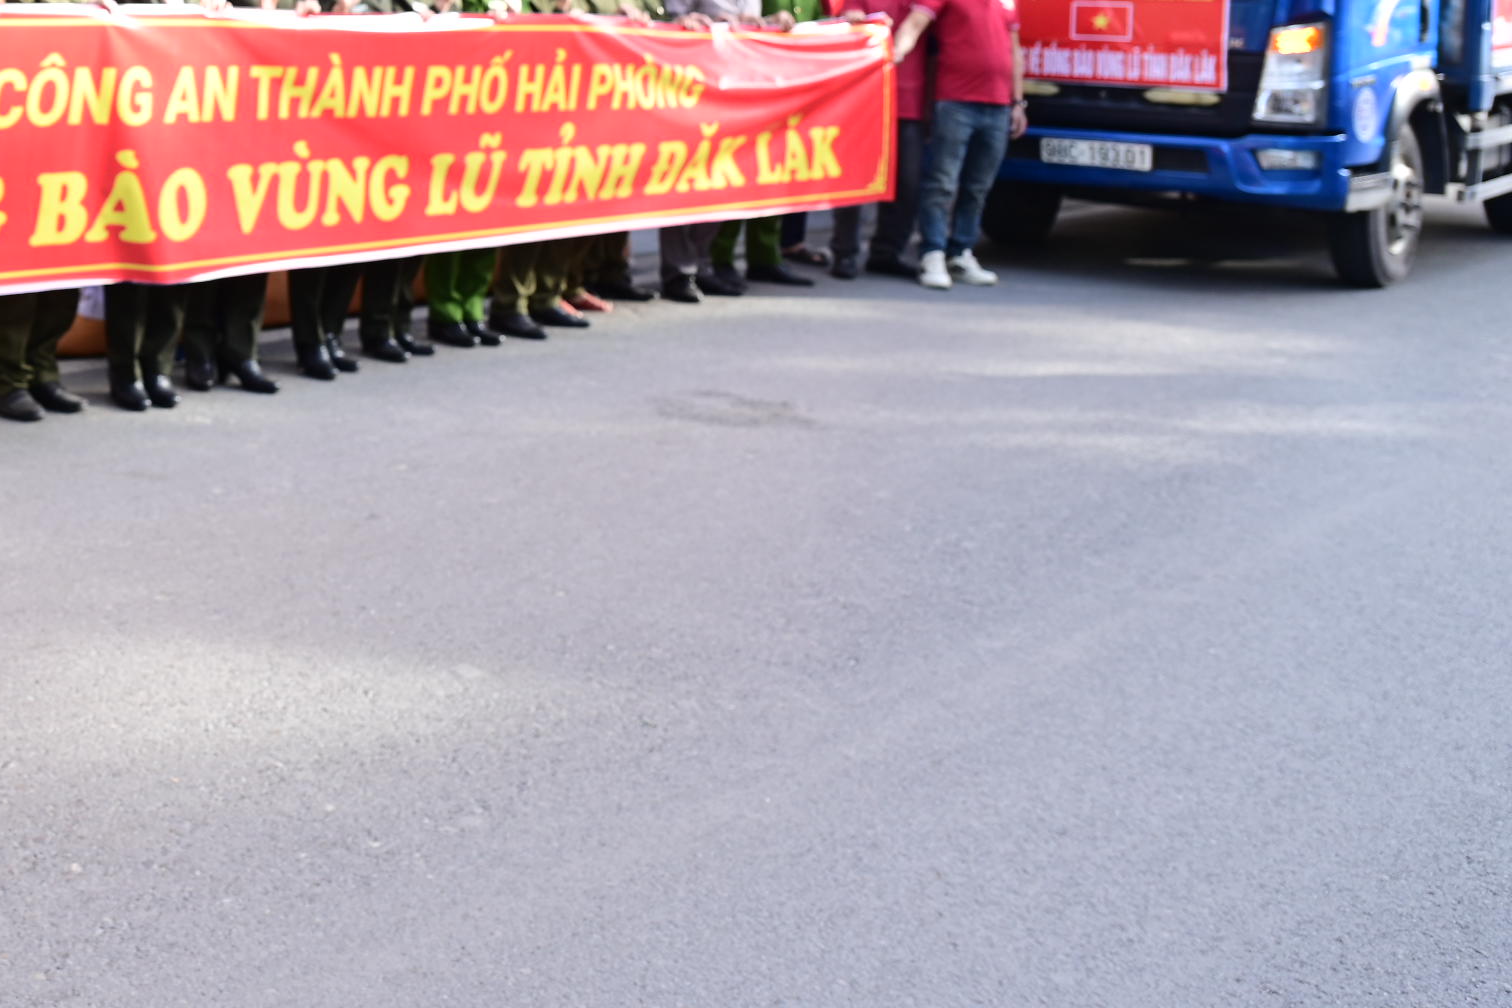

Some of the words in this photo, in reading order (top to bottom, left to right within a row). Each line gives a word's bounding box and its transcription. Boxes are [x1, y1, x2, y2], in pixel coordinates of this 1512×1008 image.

[163, 65, 239, 124] AN
[249, 53, 415, 120] THÀNH
[420, 49, 513, 116] PHỐ
[514, 48, 582, 113] HẢI
[587, 52, 705, 111] PHÒNG
[29, 149, 207, 248] BÀO
[228, 141, 411, 235] VÙNG
[425, 132, 509, 216] LŨ
[515, 122, 648, 206] TỈNH
